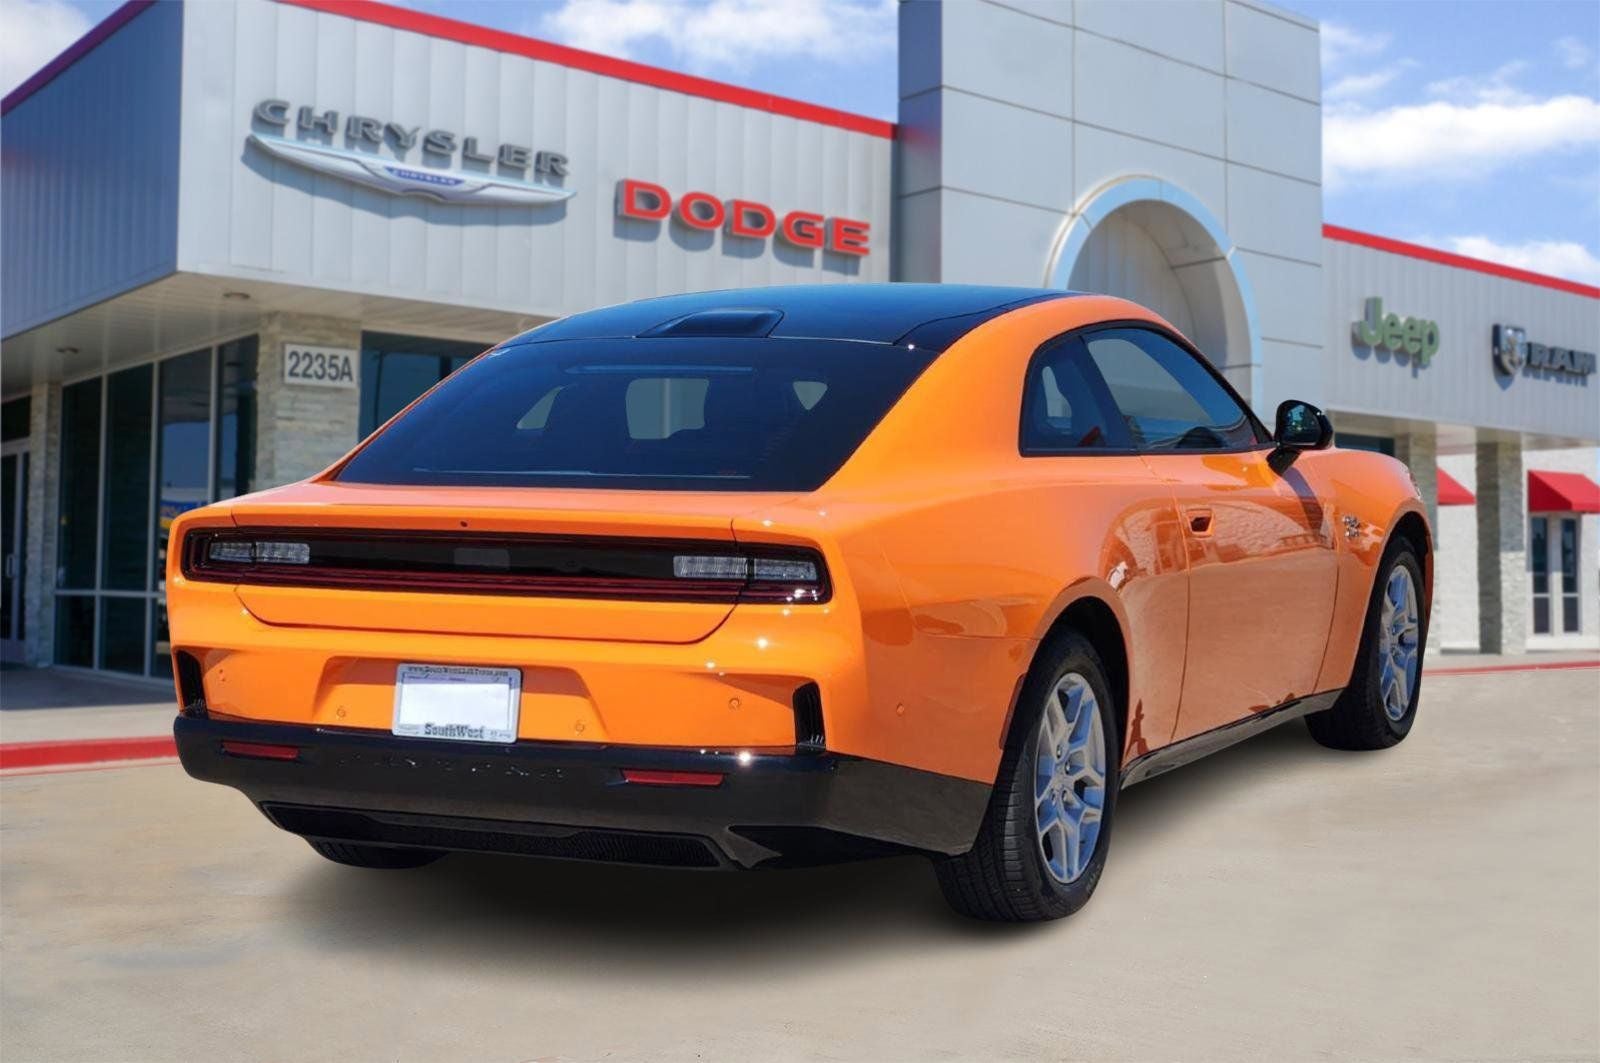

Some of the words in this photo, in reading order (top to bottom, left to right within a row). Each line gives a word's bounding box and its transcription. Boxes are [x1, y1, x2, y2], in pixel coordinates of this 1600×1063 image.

[252, 99, 569, 176] CHRYSLER
[617, 178, 870, 256] DODGE
[1355, 296, 1440, 366] Jeep
[288, 350, 353, 382] 2235A
[1526, 341, 1597, 376] RAM
[424, 723, 484, 739] SouthWest
